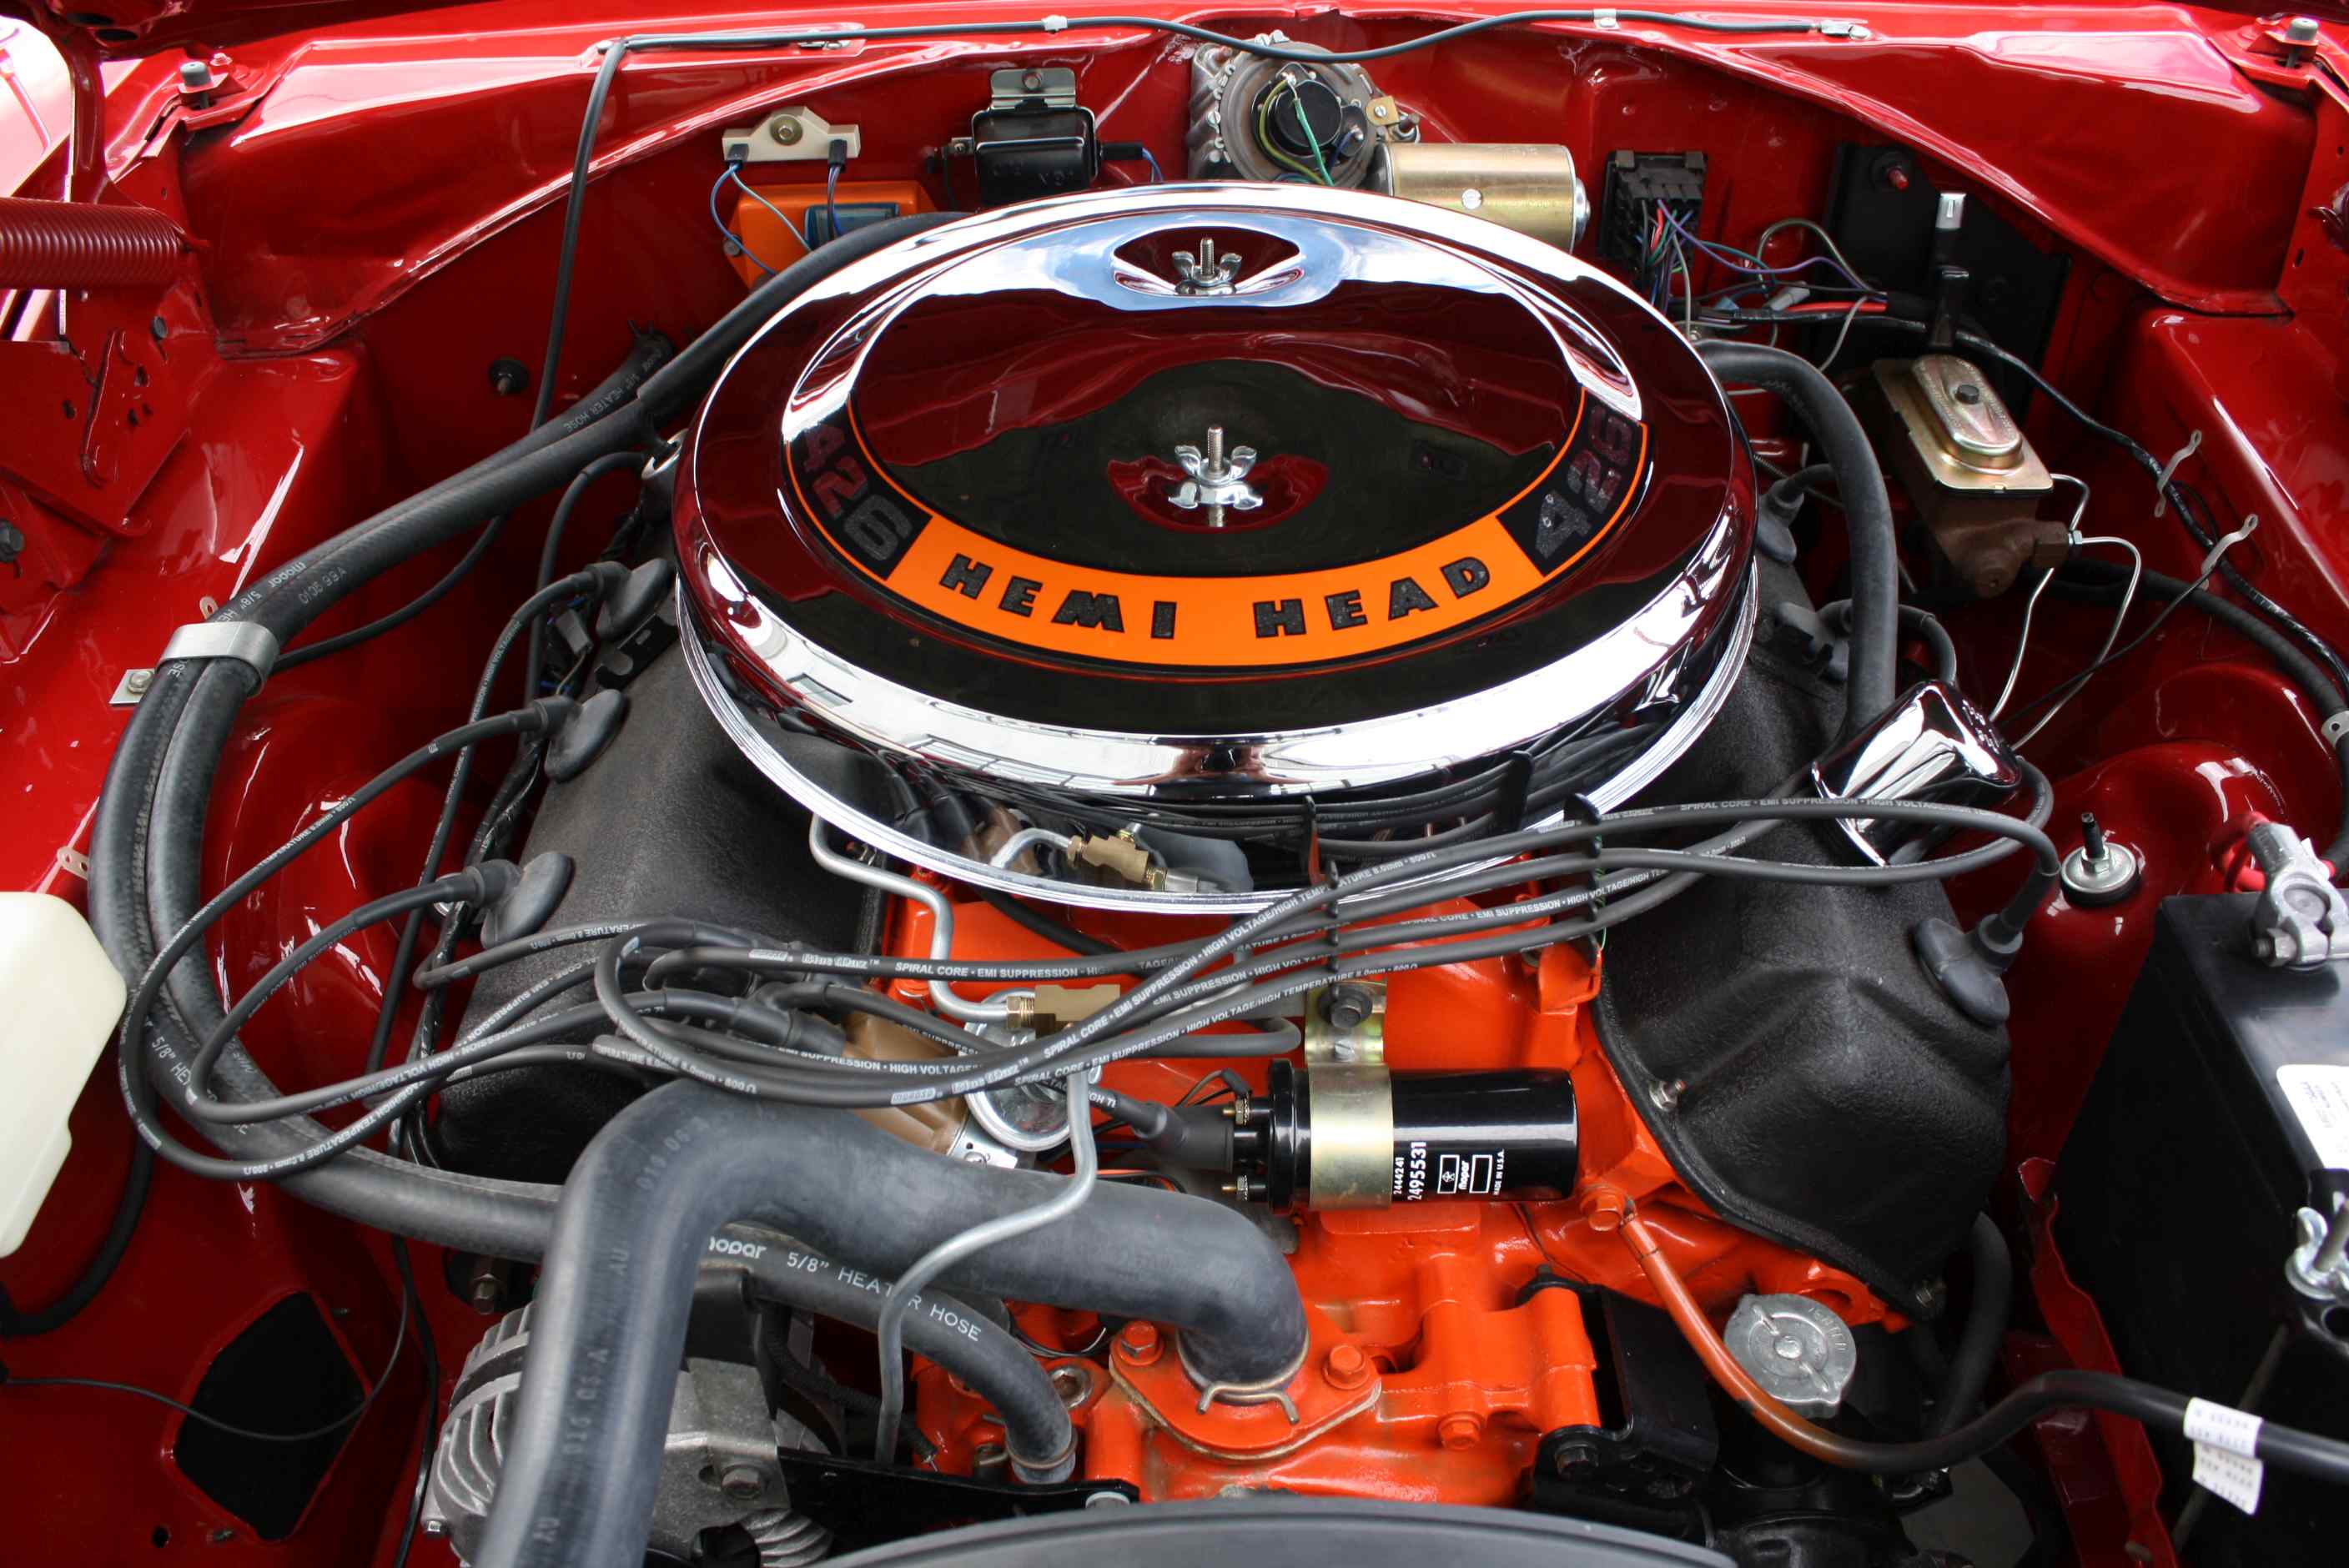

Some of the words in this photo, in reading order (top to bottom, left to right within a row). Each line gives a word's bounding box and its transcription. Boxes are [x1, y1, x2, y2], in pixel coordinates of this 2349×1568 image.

[1535, 405, 1634, 560] 426
[938, 553, 1177, 640] HEMI
[1253, 556, 1491, 638] HEAD
[1440, 912, 1469, 922] CORE
[1476, 909, 1494, 919] EMI
[1496, 898, 1561, 918] SUPPRESSION
[1567, 893, 1588, 905] HIGH
[1589, 872, 1649, 899] VOLTAGE/HIGH
[895, 962, 934, 975] SPIRAL
[937, 966, 968, 976] CORE
[978, 968, 998, 978] EMI
[1000, 968, 1079, 979] SUPPRESSION
[1043, 1036, 1080, 1059] SPIRAL
[1080, 1016, 1109, 1038] CORE
[1113, 1000, 1134, 1018] EMI
[1133, 956, 1200, 1006] SUPPRESSION
[1201, 936, 1228, 957] HIGH
[1225, 898, 1299, 942] VOLTAGE/HIGH
[1299, 867, 1372, 903] TEMPATURE
[1153, 993, 1172, 1006] EMI
[1174, 970, 1247, 1000] SUPPRESSION
[1254, 962, 1281, 977] HIGH
[466, 991, 532, 1041] SUPPRESSION
[1014, 1072, 1051, 1087] SPIRAL
[1054, 1064, 1083, 1078] CORE
[1091, 1053, 1111, 1068] EMI
[1112, 1030, 1180, 1061] SUPPRESSION
[1185, 1019, 1210, 1033] HIGH
[1212, 993, 1281, 1023] VOLTAGE/HIGH
[1283, 972, 1355, 998] TEMPERATURE
[428, 1053, 455, 1071] HIGH
[800, 1051, 881, 1071] SUPPRESSION
[889, 1063, 918, 1074] HIGH
[305, 1114, 377, 1159] TEMPERATURE
[1392, 1156, 1406, 1195] 2444241
[1406, 1141, 1427, 1201] 2495531
[1457, 1159, 1470, 1190] mopar
[1496, 1171, 1503, 1180] IN
[837, 1266, 923, 1311] HEATR
[929, 1304, 982, 1342] HOSE
